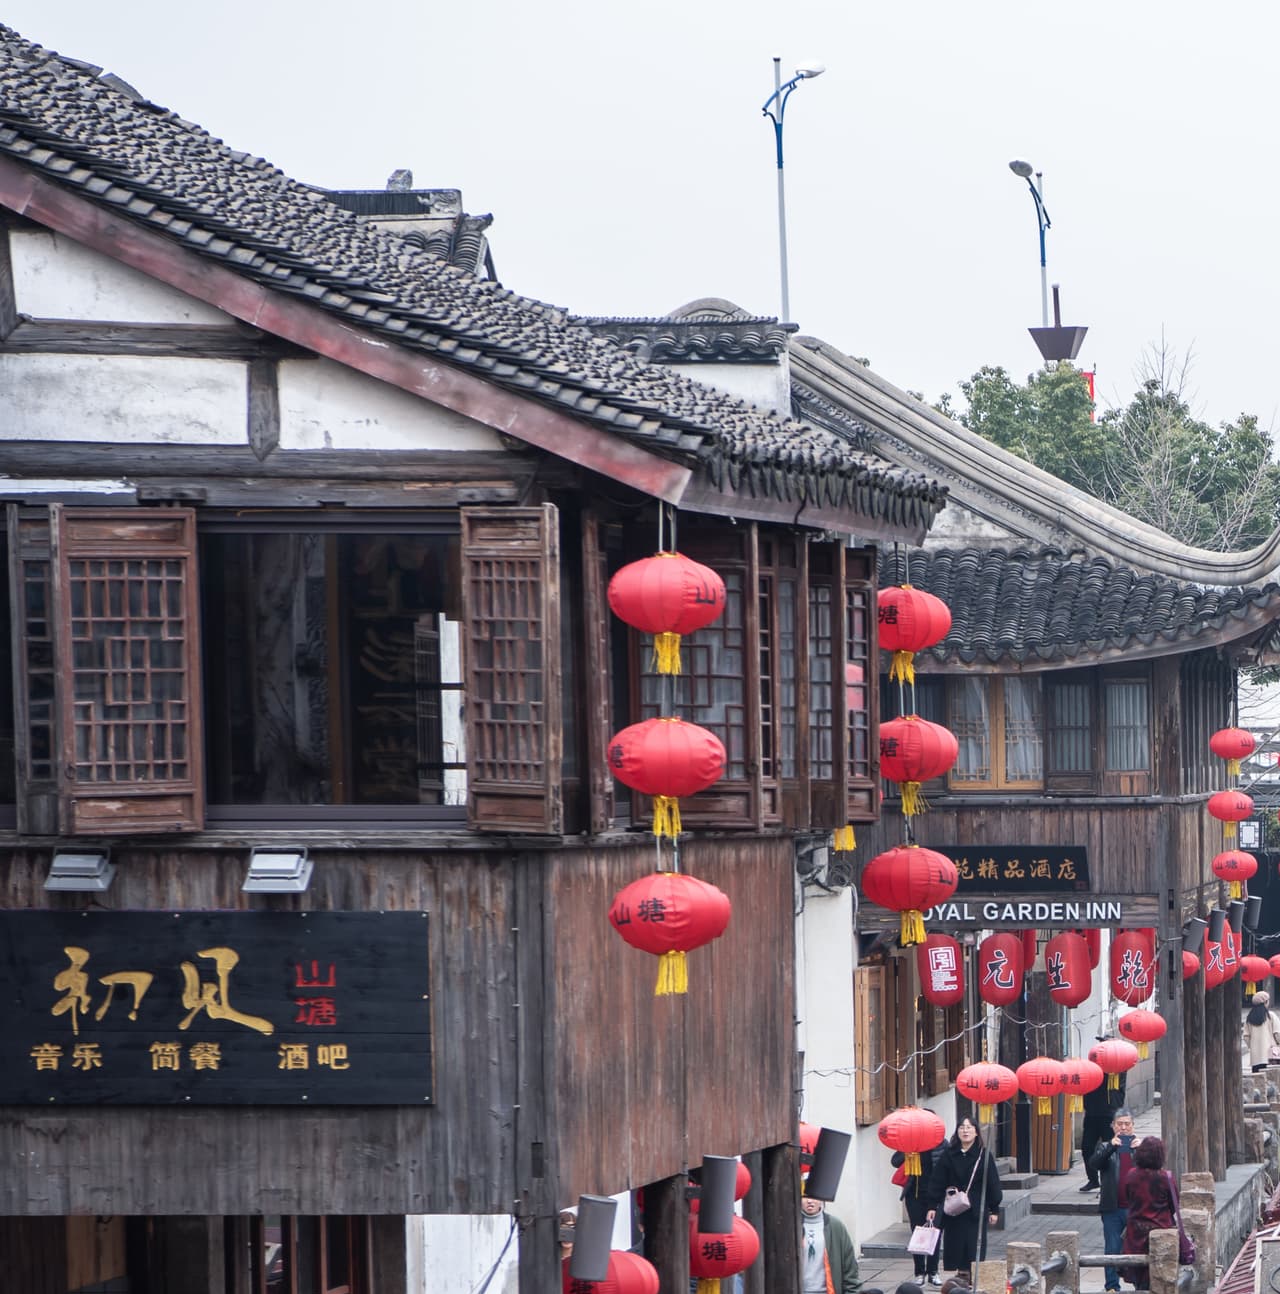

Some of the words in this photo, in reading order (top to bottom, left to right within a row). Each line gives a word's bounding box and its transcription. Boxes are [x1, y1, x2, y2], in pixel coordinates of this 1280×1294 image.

[613, 898, 667, 927] 山塘
[983, 902, 1079, 921] GARDEN
[1086, 902, 1121, 921] INN
[295, 959, 337, 1026] 山塘
[31, 1042, 103, 1071] 音乐
[149, 1041, 222, 1071] 简餐
[277, 1043, 350, 1071] 酒吧
[965, 1076, 1000, 1091] 山塘
